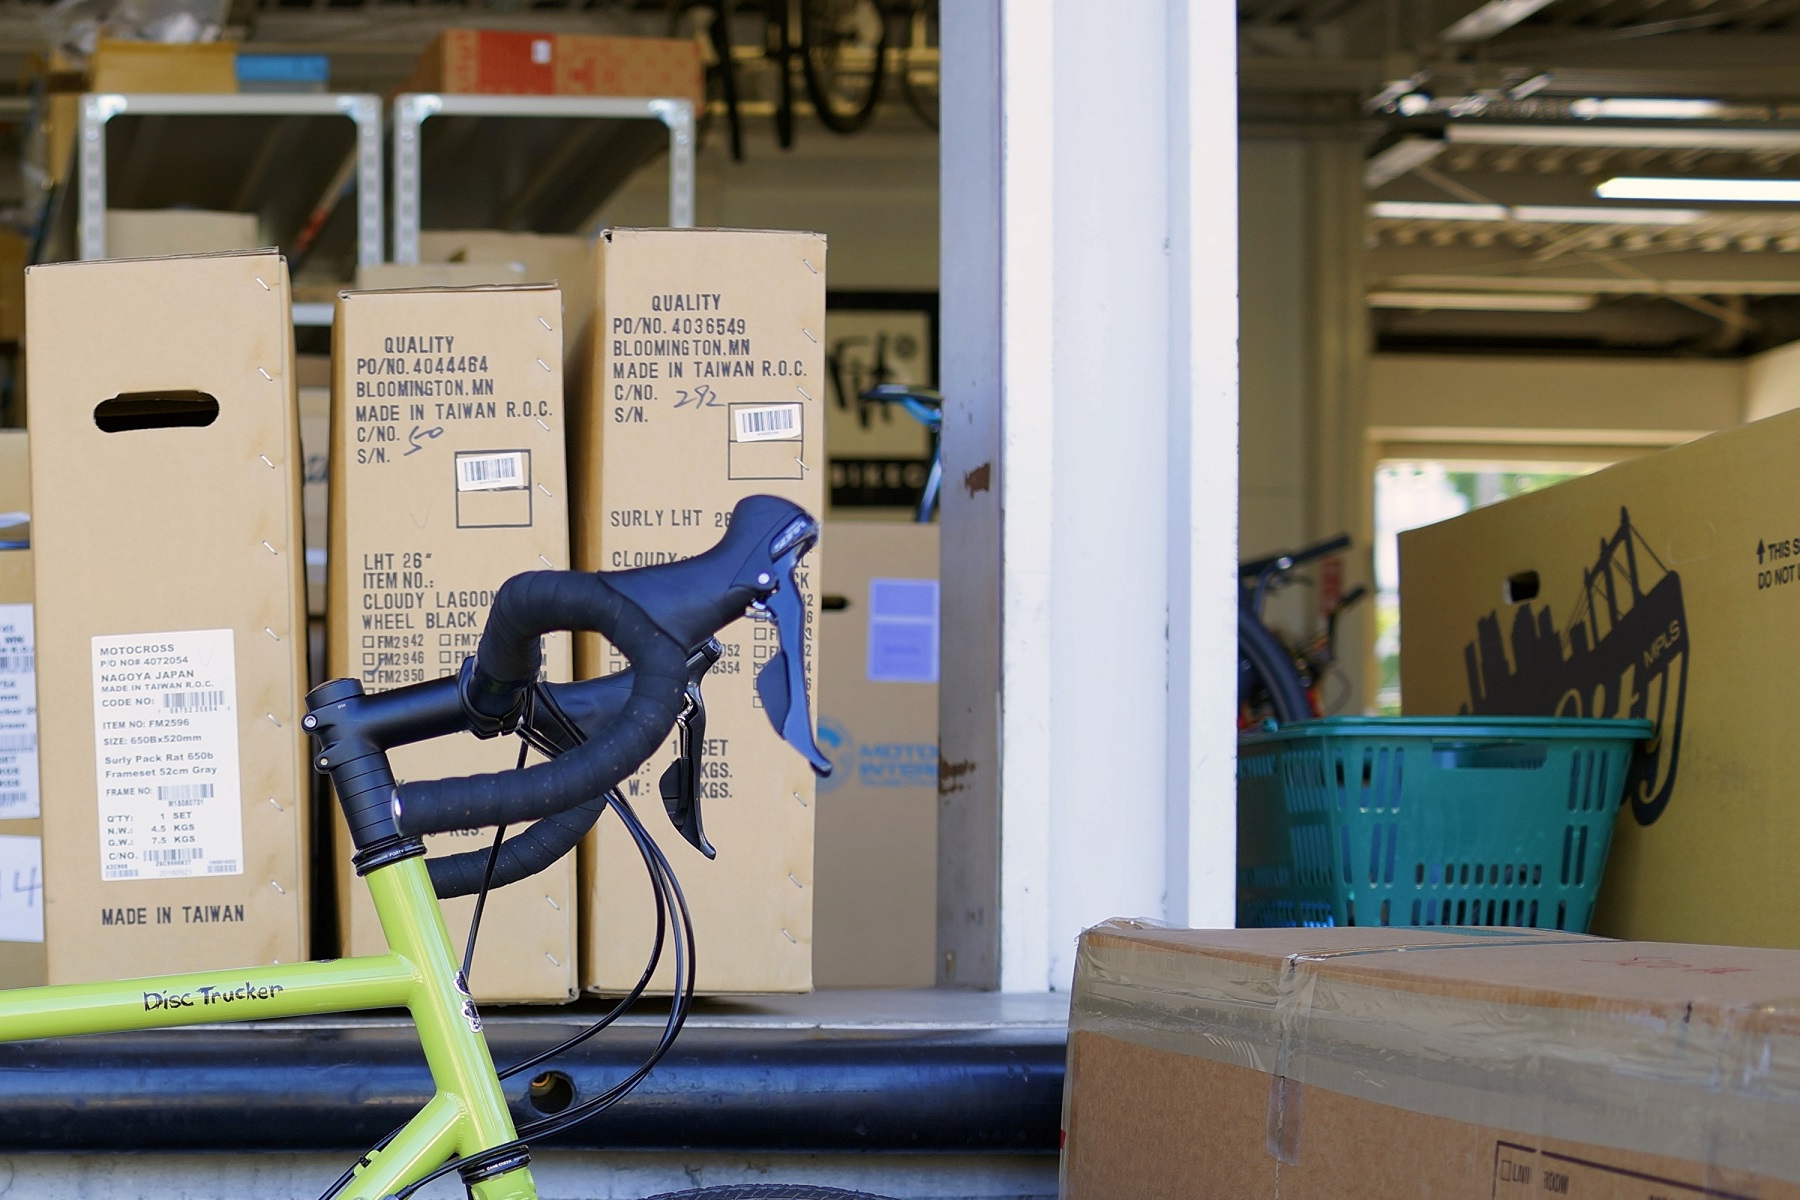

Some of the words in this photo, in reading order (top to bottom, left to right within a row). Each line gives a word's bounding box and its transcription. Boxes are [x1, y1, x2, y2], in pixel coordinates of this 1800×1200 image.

[652, 294, 720, 311] QUALITY
[384, 336, 454, 354] QUALITY
[614, 362, 658, 378] MADE
[669, 362, 682, 378] IN
[694, 360, 754, 378] TAIWAN
[762, 360, 807, 376] R.O.C.
[614, 384, 658, 400] C/NO.
[356, 405, 400, 422] MADE
[410, 404, 424, 420] IN
[435, 402, 496, 420] TAIWAN
[506, 401, 552, 418] R.O.C.
[614, 406, 648, 422] S/N.
[357, 426, 400, 442] C/NO.
[357, 448, 390, 464] S/N.
[610, 510, 663, 527] SURLY
[672, 510, 703, 526] LHT
[1768, 540, 1790, 561] THIS
[364, 554, 394, 570] LHT
[363, 572, 398, 588] ITEM
[402, 572, 434, 588] NO.:
[1758, 570, 1772, 590] DO
[1774, 564, 1795, 586] NOT
[364, 592, 424, 610] CLOUDY
[362, 614, 414, 630] WHEEL
[426, 612, 477, 629] BLACK
[378, 635, 424, 648] FM2942
[1643, 620, 1680, 669] MPLS
[100, 644, 175, 656] MOTOCROSS
[120, 658, 140, 666] NO#
[144, 656, 188, 666] 4072054
[378, 652, 424, 665] FM2946
[101, 672, 151, 682] NAGOYA
[155, 670, 194, 680] JAPAN
[378, 668, 424, 682] FM2950
[102, 698, 132, 707] CODE
[136, 698, 154, 706] NO:
[103, 722, 126, 730] ITEM
[129, 720, 146, 728] NO:
[149, 718, 190, 728] FM2596
[104, 738, 128, 746] SIZE:
[130, 734, 202, 744] 650Bx520mm
[105, 756, 132, 766] Surly
[136, 754, 162, 763] Pack
[106, 769, 156, 778] Frameset
[160, 767, 188, 776] 52cm
[192, 766, 217, 775] Gray
[138, 787, 152, 795] NO:
[108, 852, 138, 860] C/NO.
[102, 908, 146, 926] MADE
[157, 906, 172, 924] IN
[182, 904, 244, 922] TAIWAN
[143, 990, 194, 1012] Disc
[196, 982, 284, 1006] Trucker
